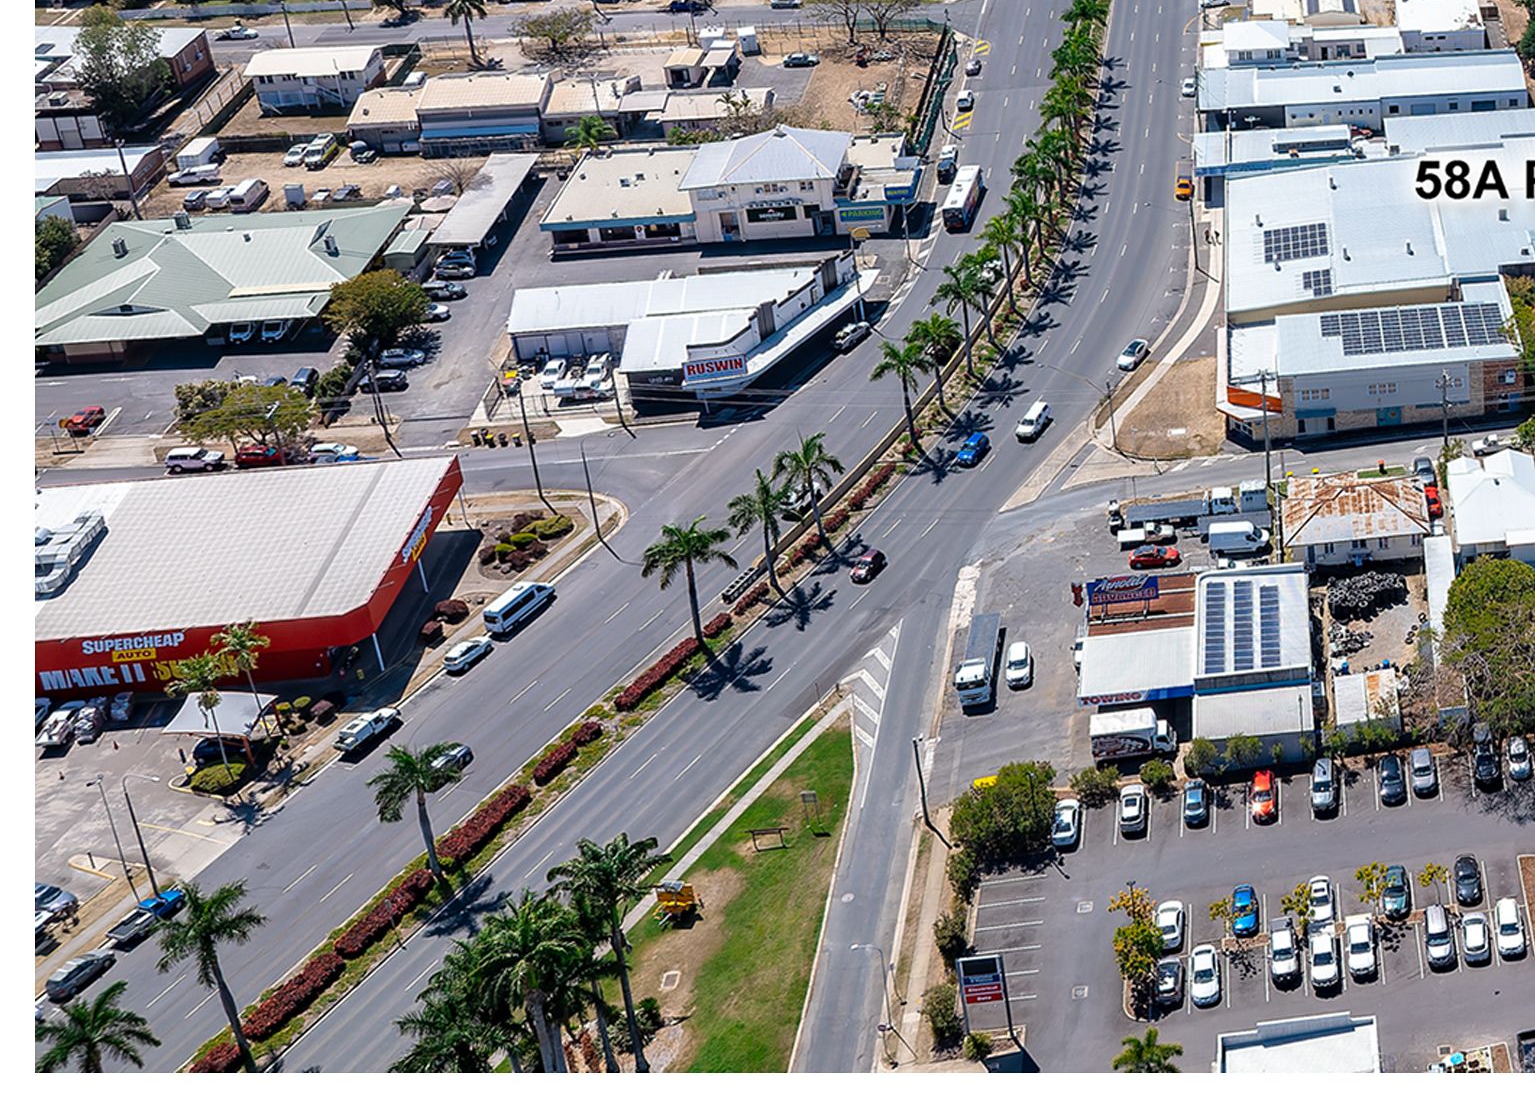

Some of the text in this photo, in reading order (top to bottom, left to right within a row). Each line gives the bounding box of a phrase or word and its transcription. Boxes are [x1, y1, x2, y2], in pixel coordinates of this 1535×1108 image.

[686, 358, 744, 376] RUSWIN
[81, 631, 185, 655] SUPERCHEAP
[116, 649, 152, 661] AUTO
[40, 665, 119, 690] MAKE
[119, 662, 146, 684] IT
[1080, 691, 1142, 706] TOWING
